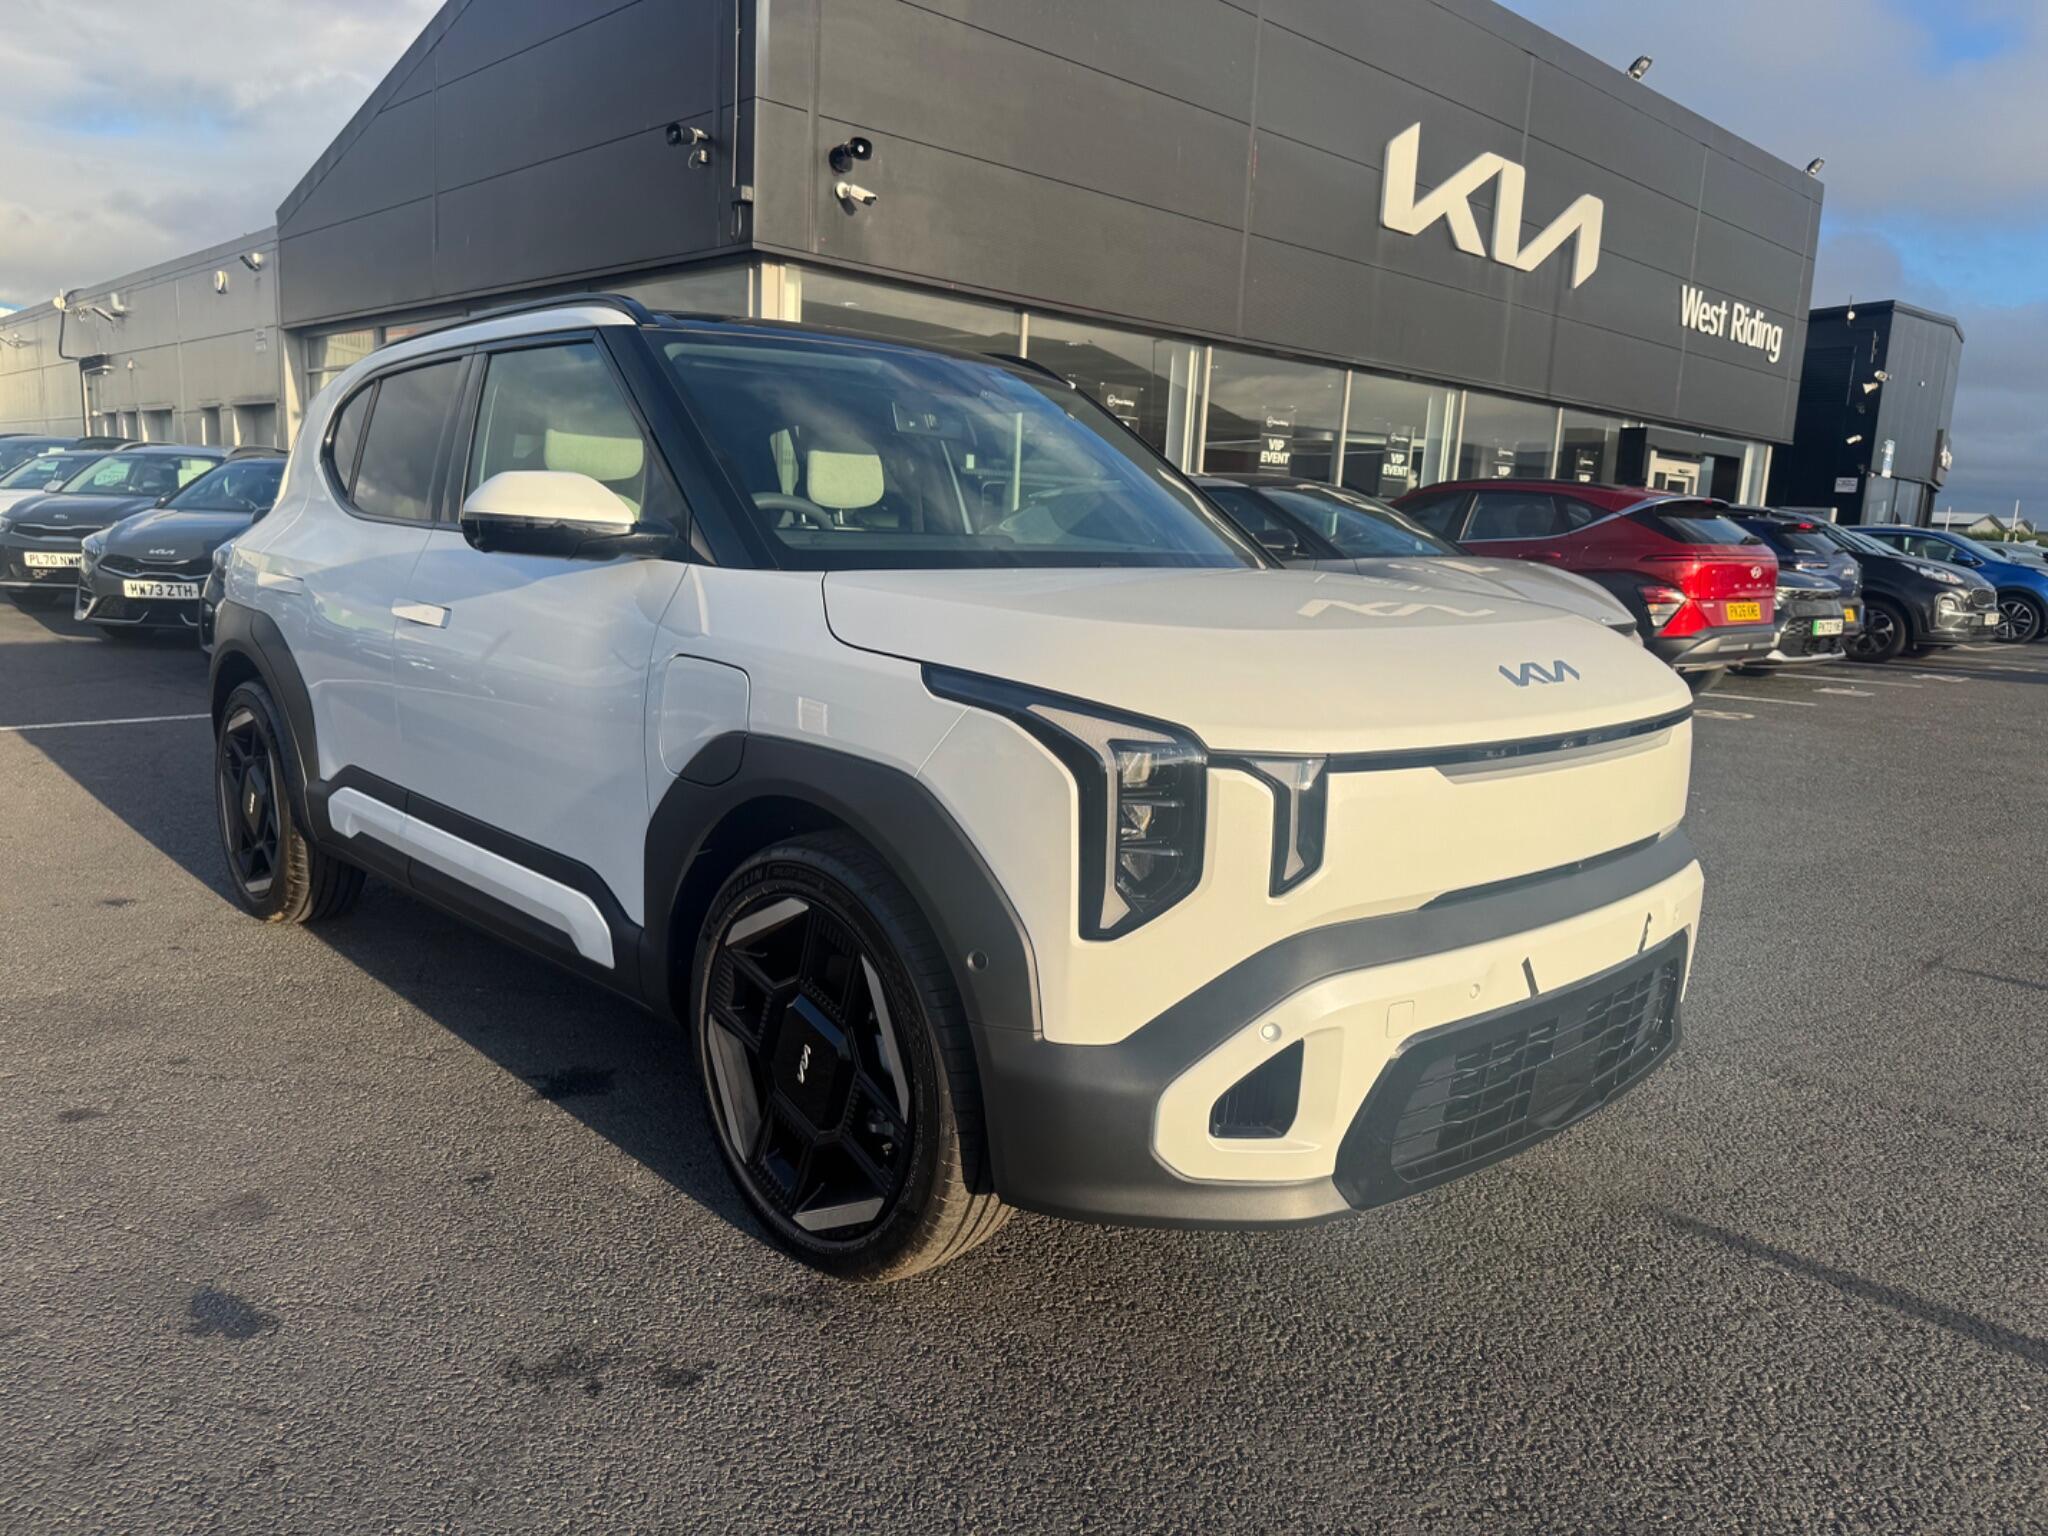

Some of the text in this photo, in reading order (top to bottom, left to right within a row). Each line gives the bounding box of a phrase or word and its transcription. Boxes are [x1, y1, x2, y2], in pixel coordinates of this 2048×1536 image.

[1681, 284, 1783, 363] West Riding
[1268, 438, 1285, 451] VIP
[1260, 450, 1290, 464] EVENT
[130, 583, 193, 597] MW73 ZTH
